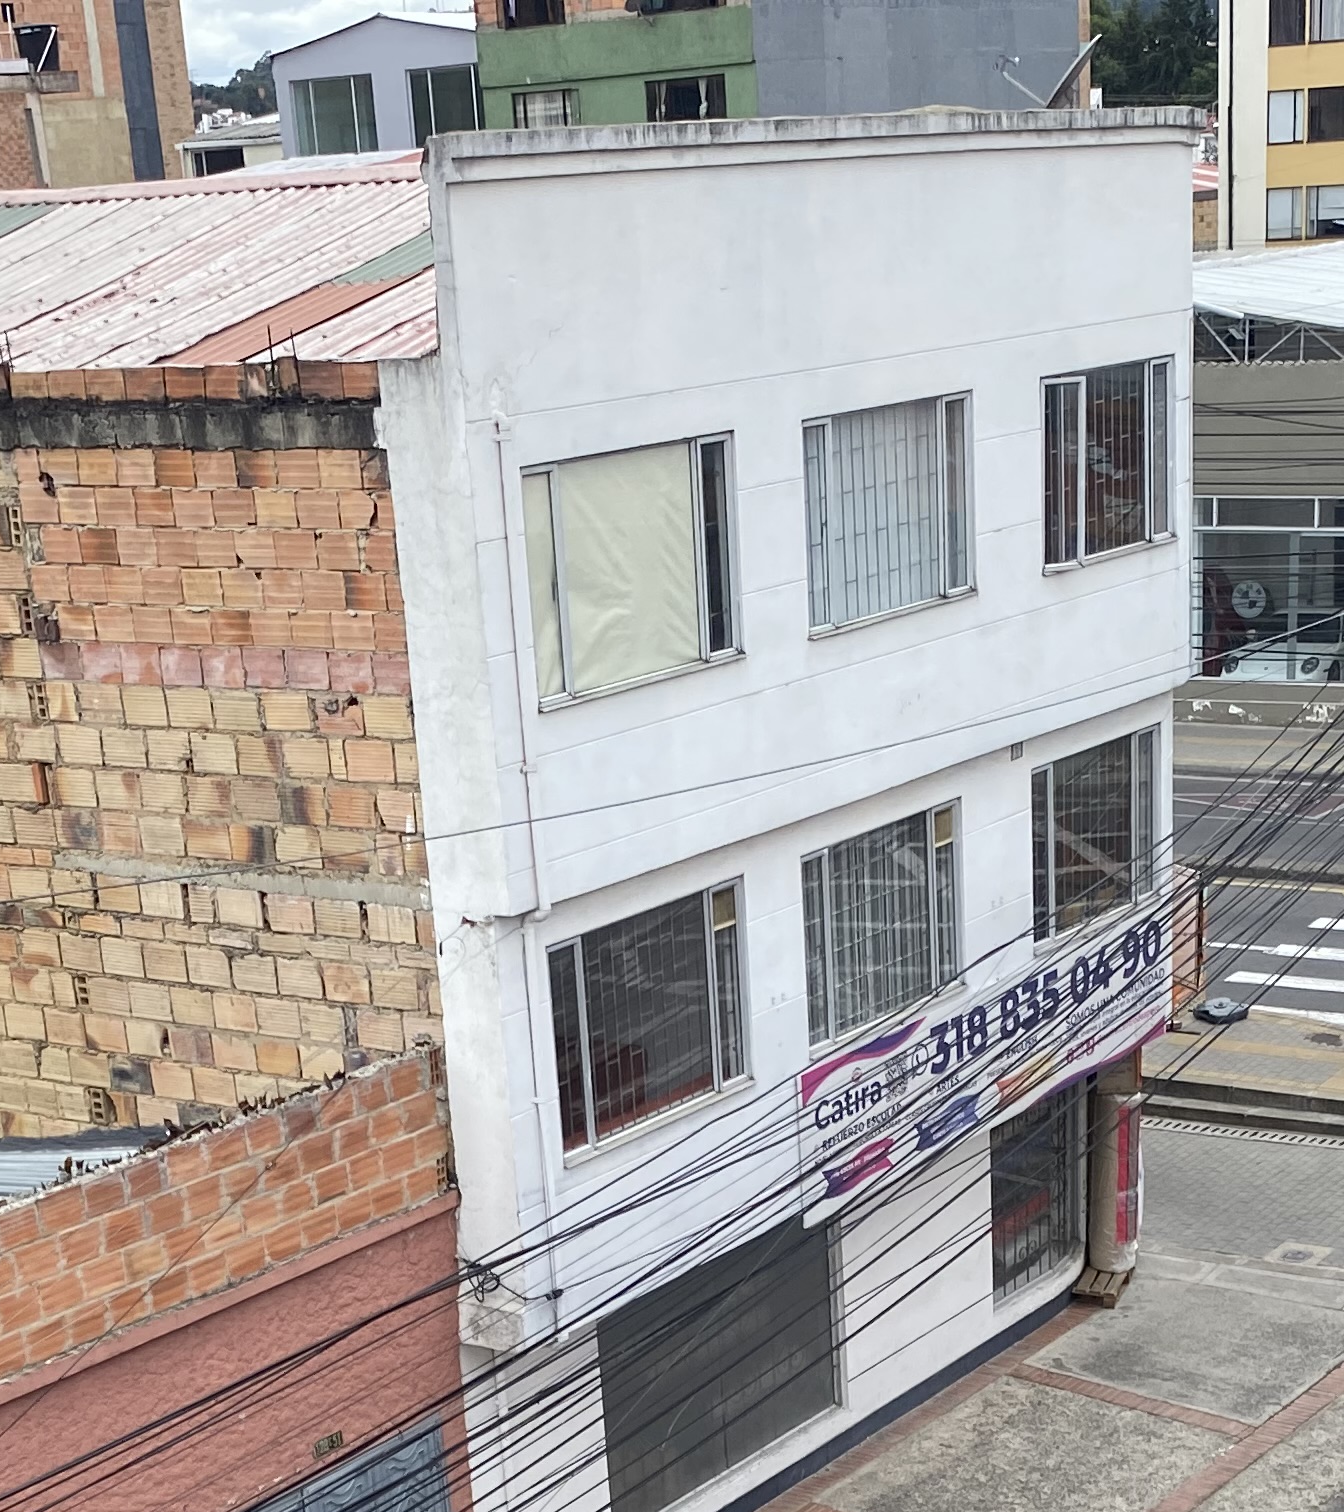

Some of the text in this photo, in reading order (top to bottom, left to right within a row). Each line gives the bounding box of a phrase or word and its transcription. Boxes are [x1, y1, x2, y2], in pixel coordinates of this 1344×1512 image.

[930, 1005, 988, 1076] 318
[999, 968, 1062, 1040] 835
[1070, 942, 1116, 1003] 04
[1122, 919, 1163, 979] 90
[814, 1079, 882, 1130] Catira
